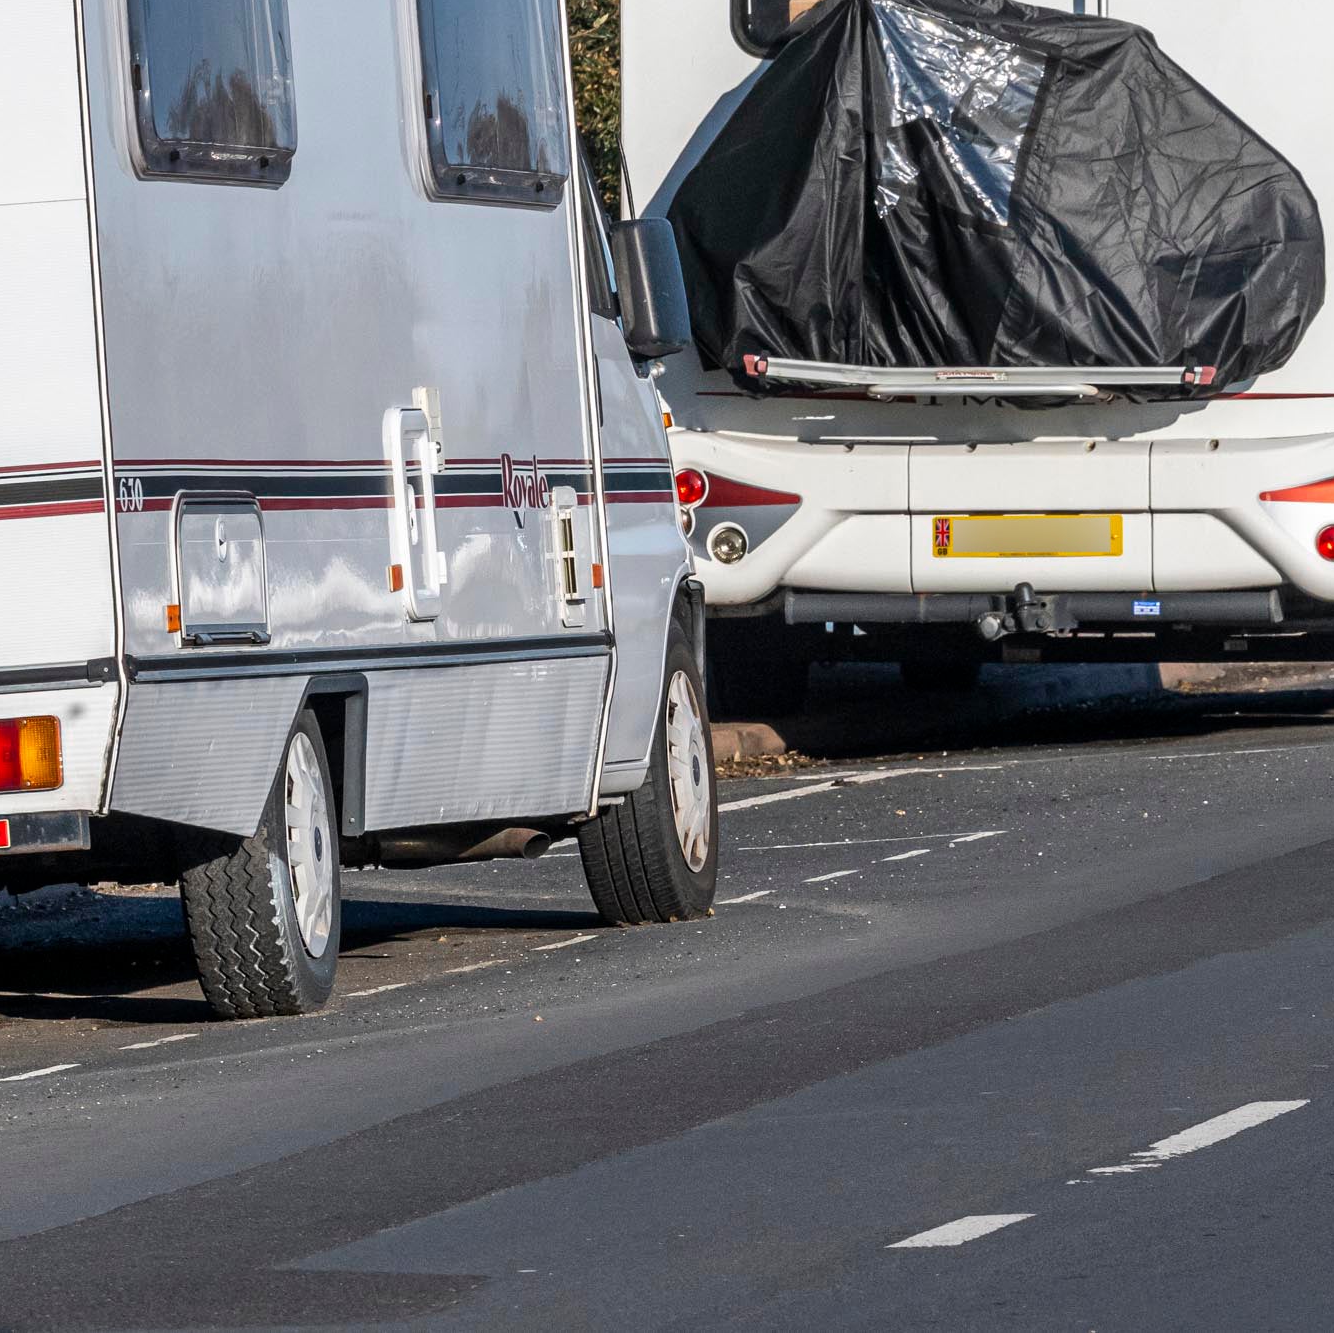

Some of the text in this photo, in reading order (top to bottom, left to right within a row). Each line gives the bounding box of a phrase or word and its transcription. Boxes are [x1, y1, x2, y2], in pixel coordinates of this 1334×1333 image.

[120, 477, 143, 512] 630
[501, 453, 549, 529] Royale
[937, 548, 948, 556] GB
